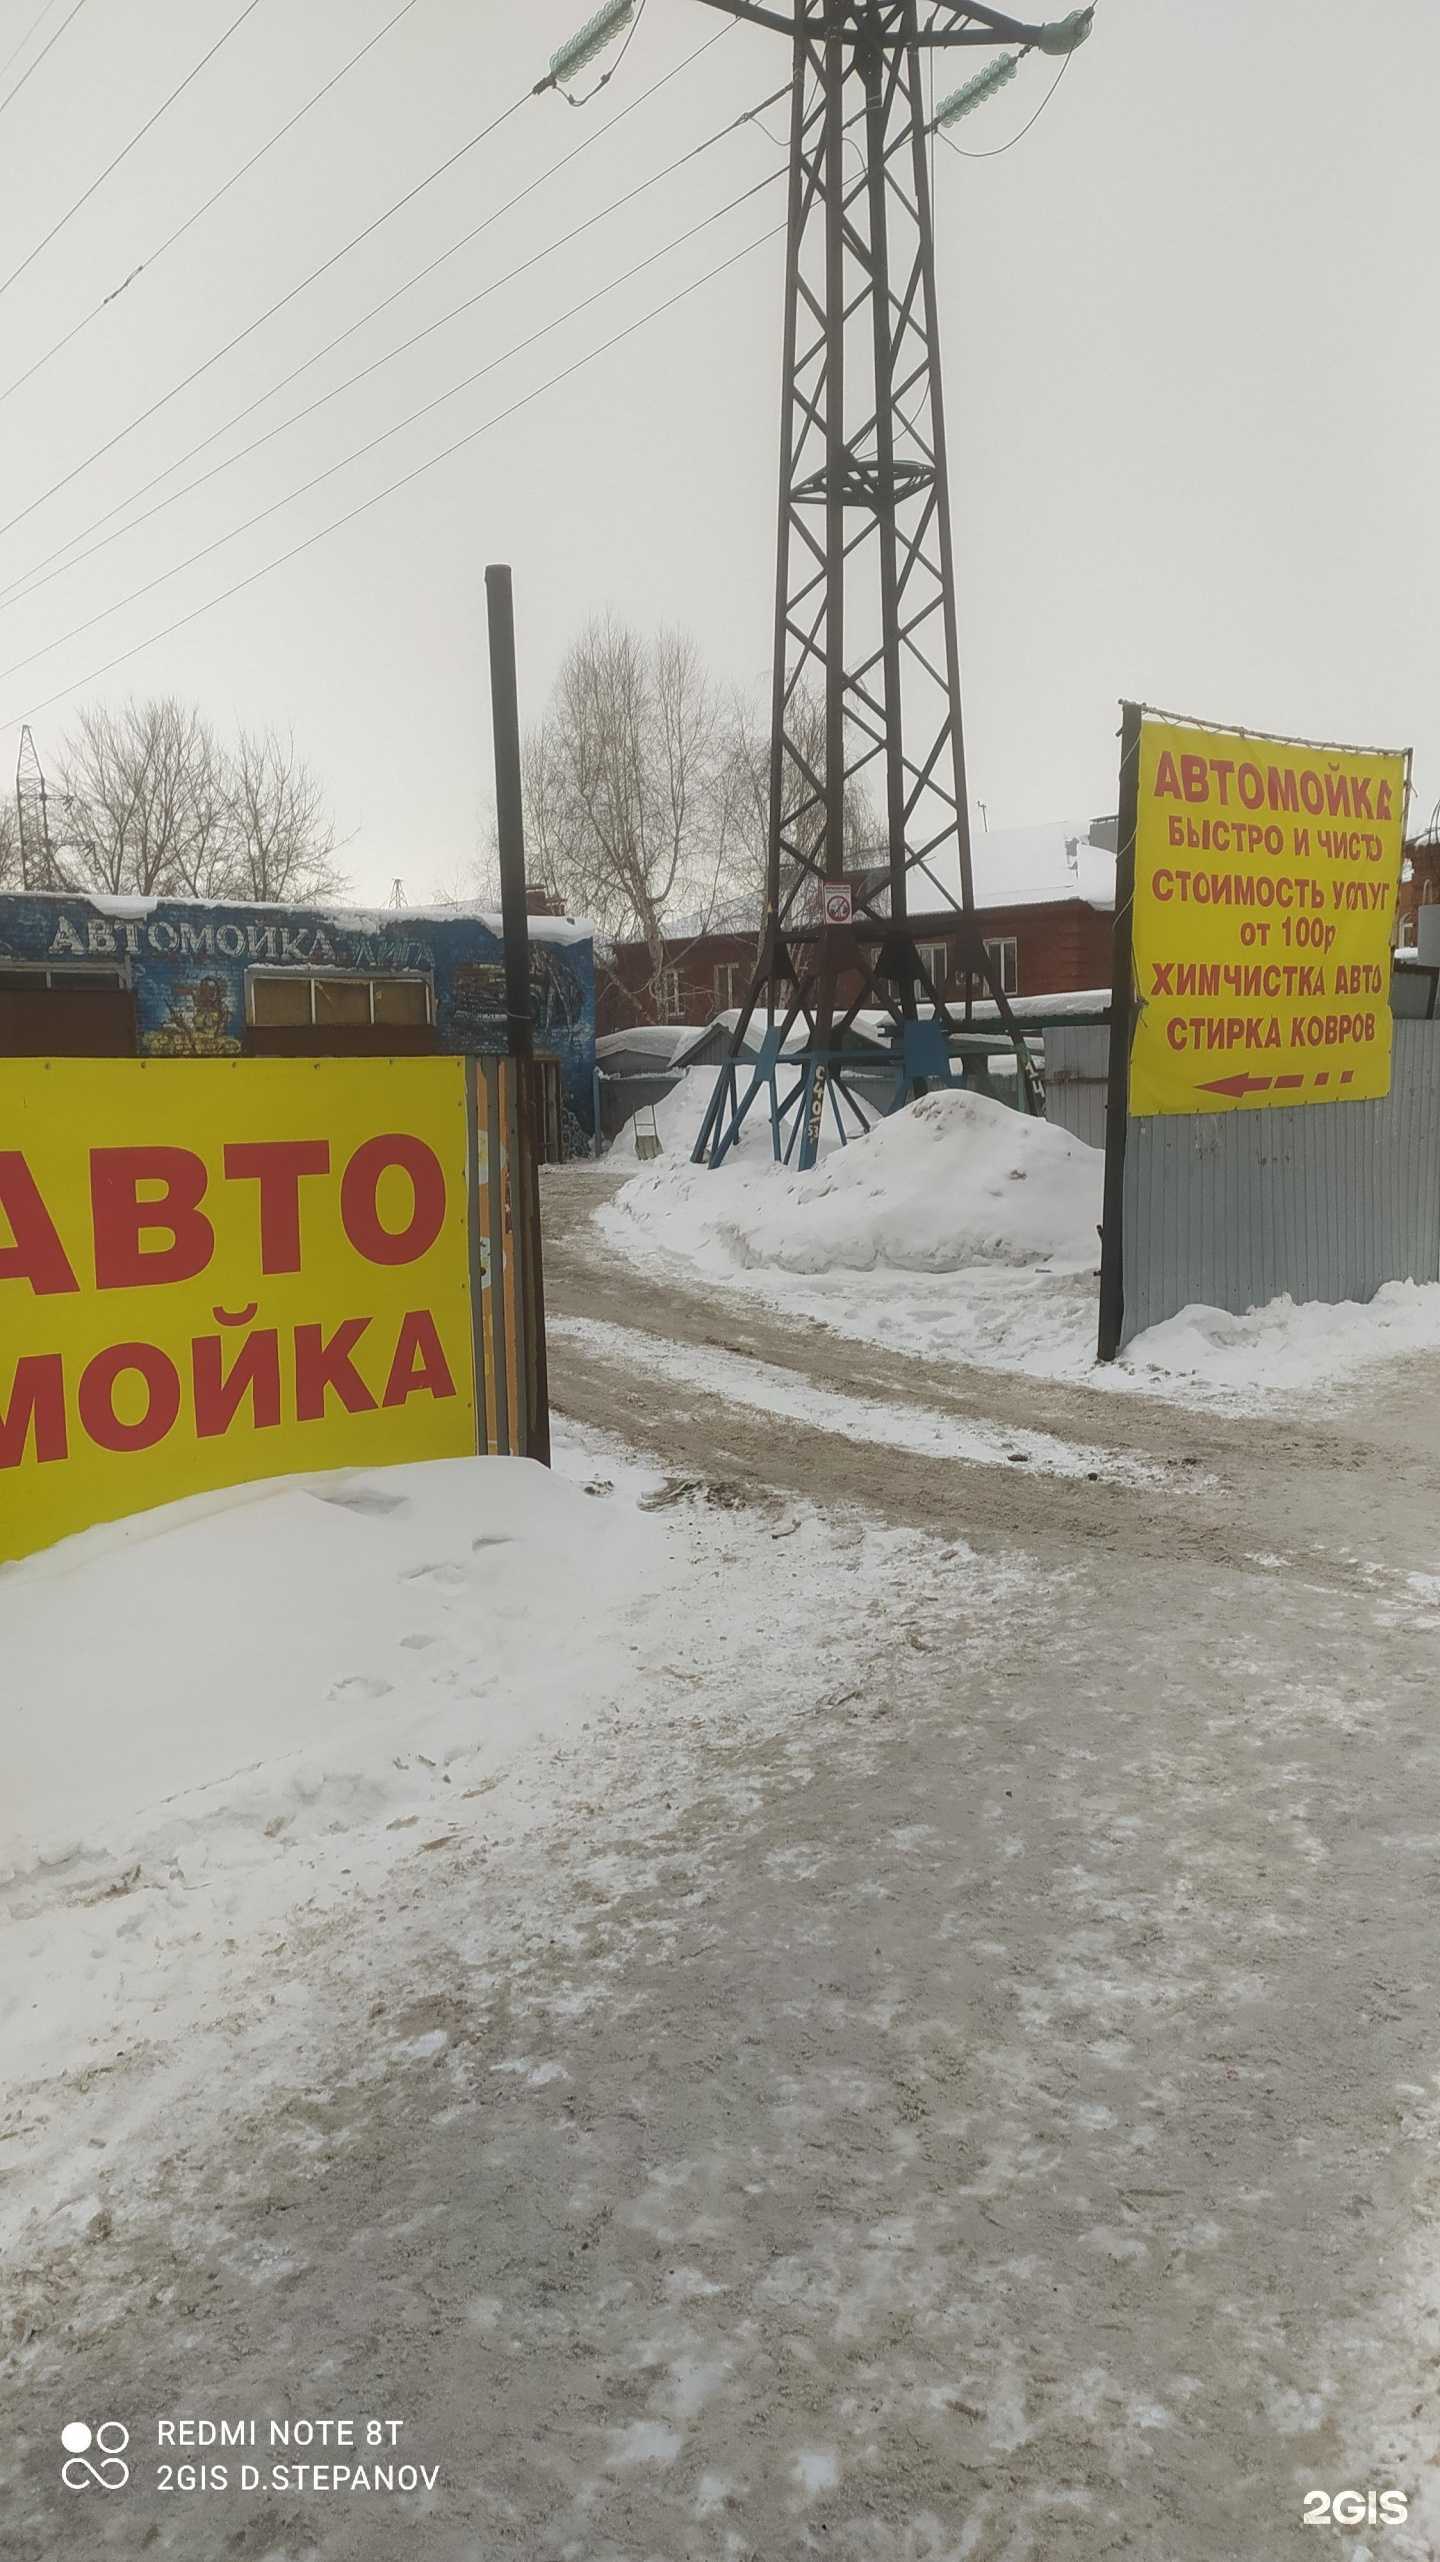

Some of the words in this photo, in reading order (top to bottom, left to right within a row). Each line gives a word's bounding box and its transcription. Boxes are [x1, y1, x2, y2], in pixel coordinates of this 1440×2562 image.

[1154, 750, 1393, 821] АВТОМОЙКА
[1168, 815, 1284, 856] БЫСТРО
[1294, 827, 1310, 857] И
[1317, 829, 1383, 862] ЧИСТО
[1152, 868, 1325, 909] СТОИМОСТЬ
[49, 916, 336, 960] АВТОМОЙКА
[1240, 922, 1271, 946] от
[1151, 963, 1326, 997] ХИМЧИСТКА
[1334, 964, 1383, 995] АВТО
[1166, 1014, 1281, 1051] СТИРКА
[1290, 1012, 1376, 1048] КОВРОВ
